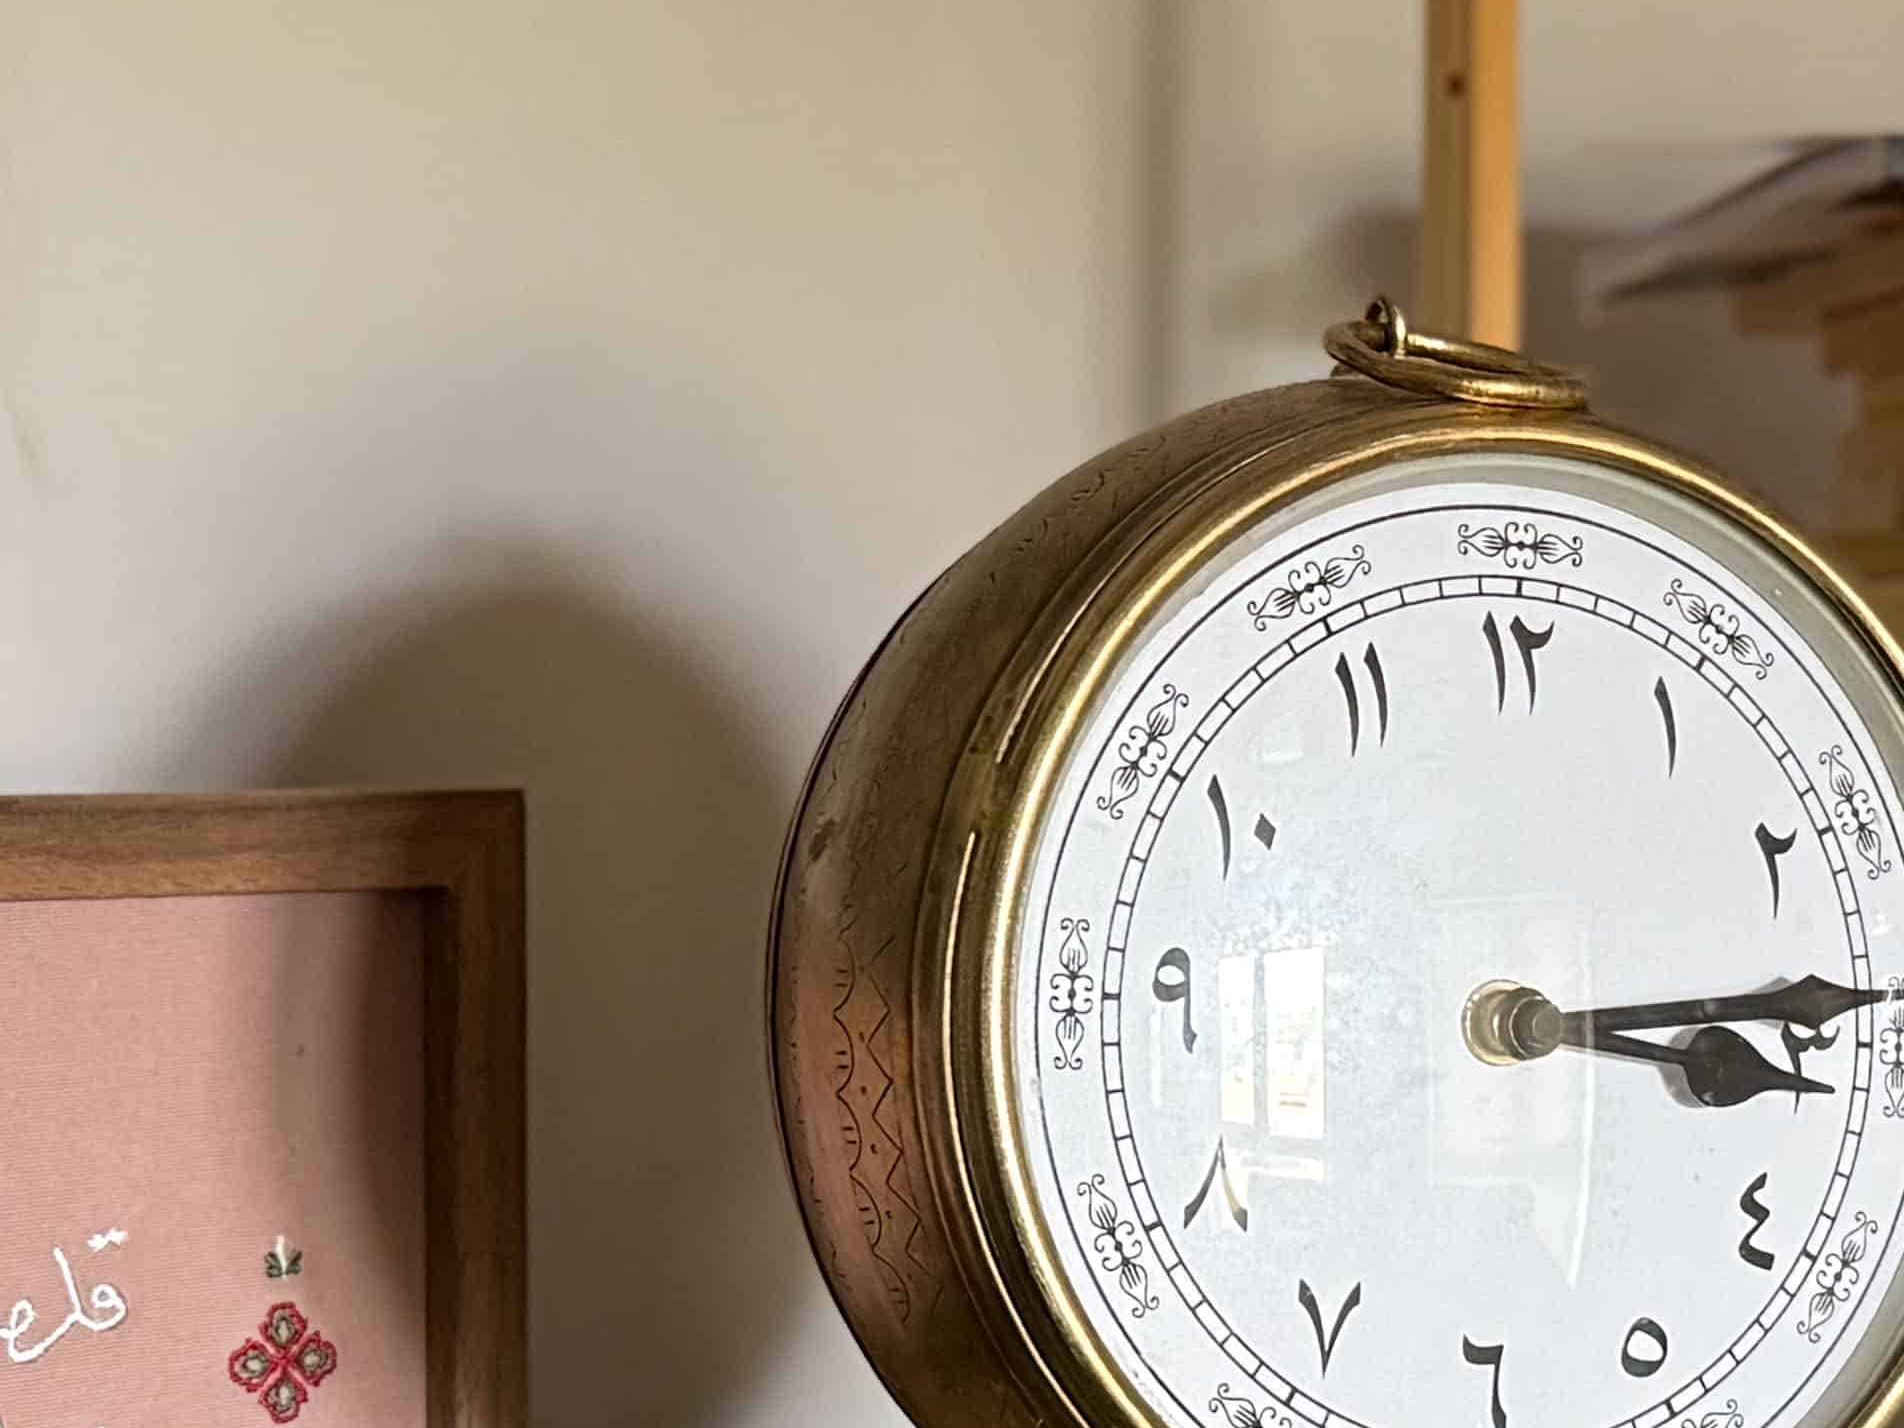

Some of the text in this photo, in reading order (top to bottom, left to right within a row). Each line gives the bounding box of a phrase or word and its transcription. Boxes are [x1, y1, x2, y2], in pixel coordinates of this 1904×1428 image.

[1335, 641, 1391, 759] ١١
[1483, 609, 1555, 717] ١٢
[1653, 675, 1678, 779] ١
[1752, 820, 1798, 920] ٢
[1151, 945, 1200, 1054] ٩
[1182, 1133, 1250, 1234] ٨
[1297, 1277, 1363, 1378] ٧
